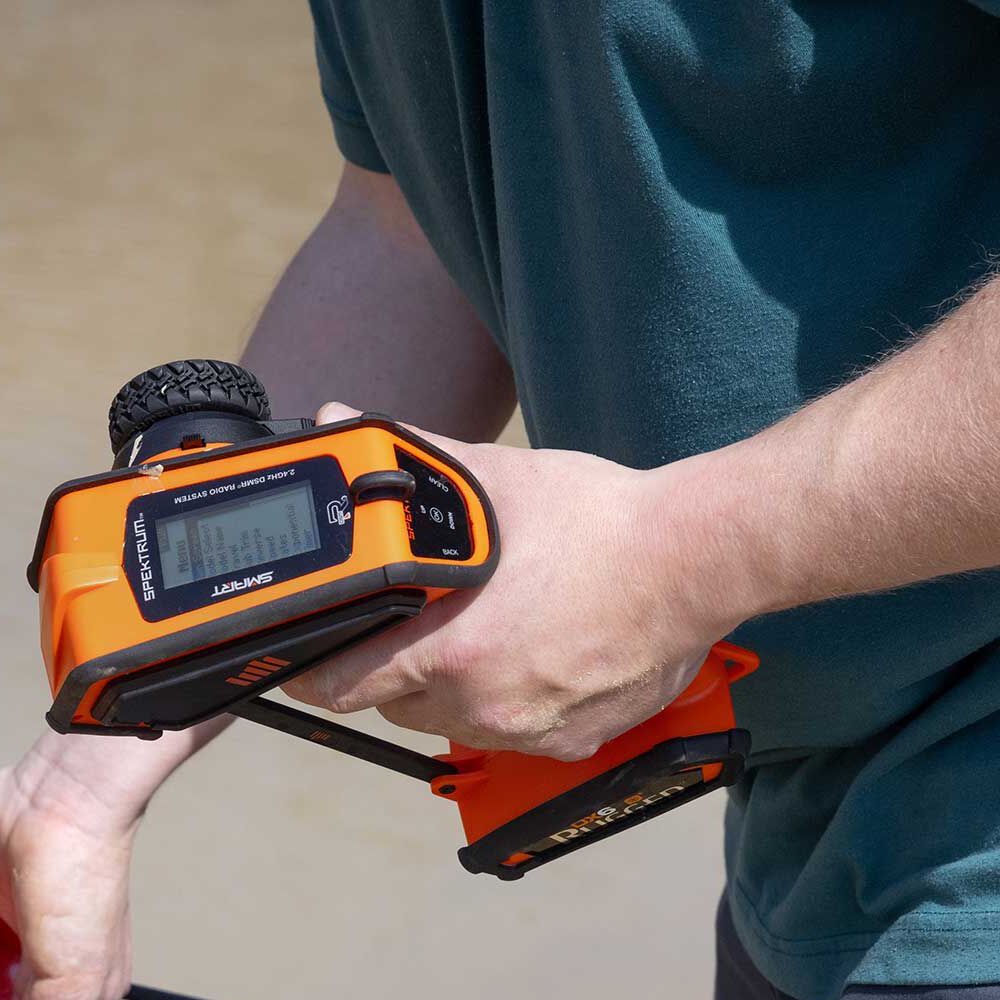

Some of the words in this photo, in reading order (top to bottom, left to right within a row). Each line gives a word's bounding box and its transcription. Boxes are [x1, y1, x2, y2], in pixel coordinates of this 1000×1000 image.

[267, 469, 295, 481] 2.4GHz
[209, 483, 236, 496] RADIO
[428, 475, 449, 493] CLEAR
[174, 490, 208, 504] SYSTEM
[211, 571, 273, 597] SMART
